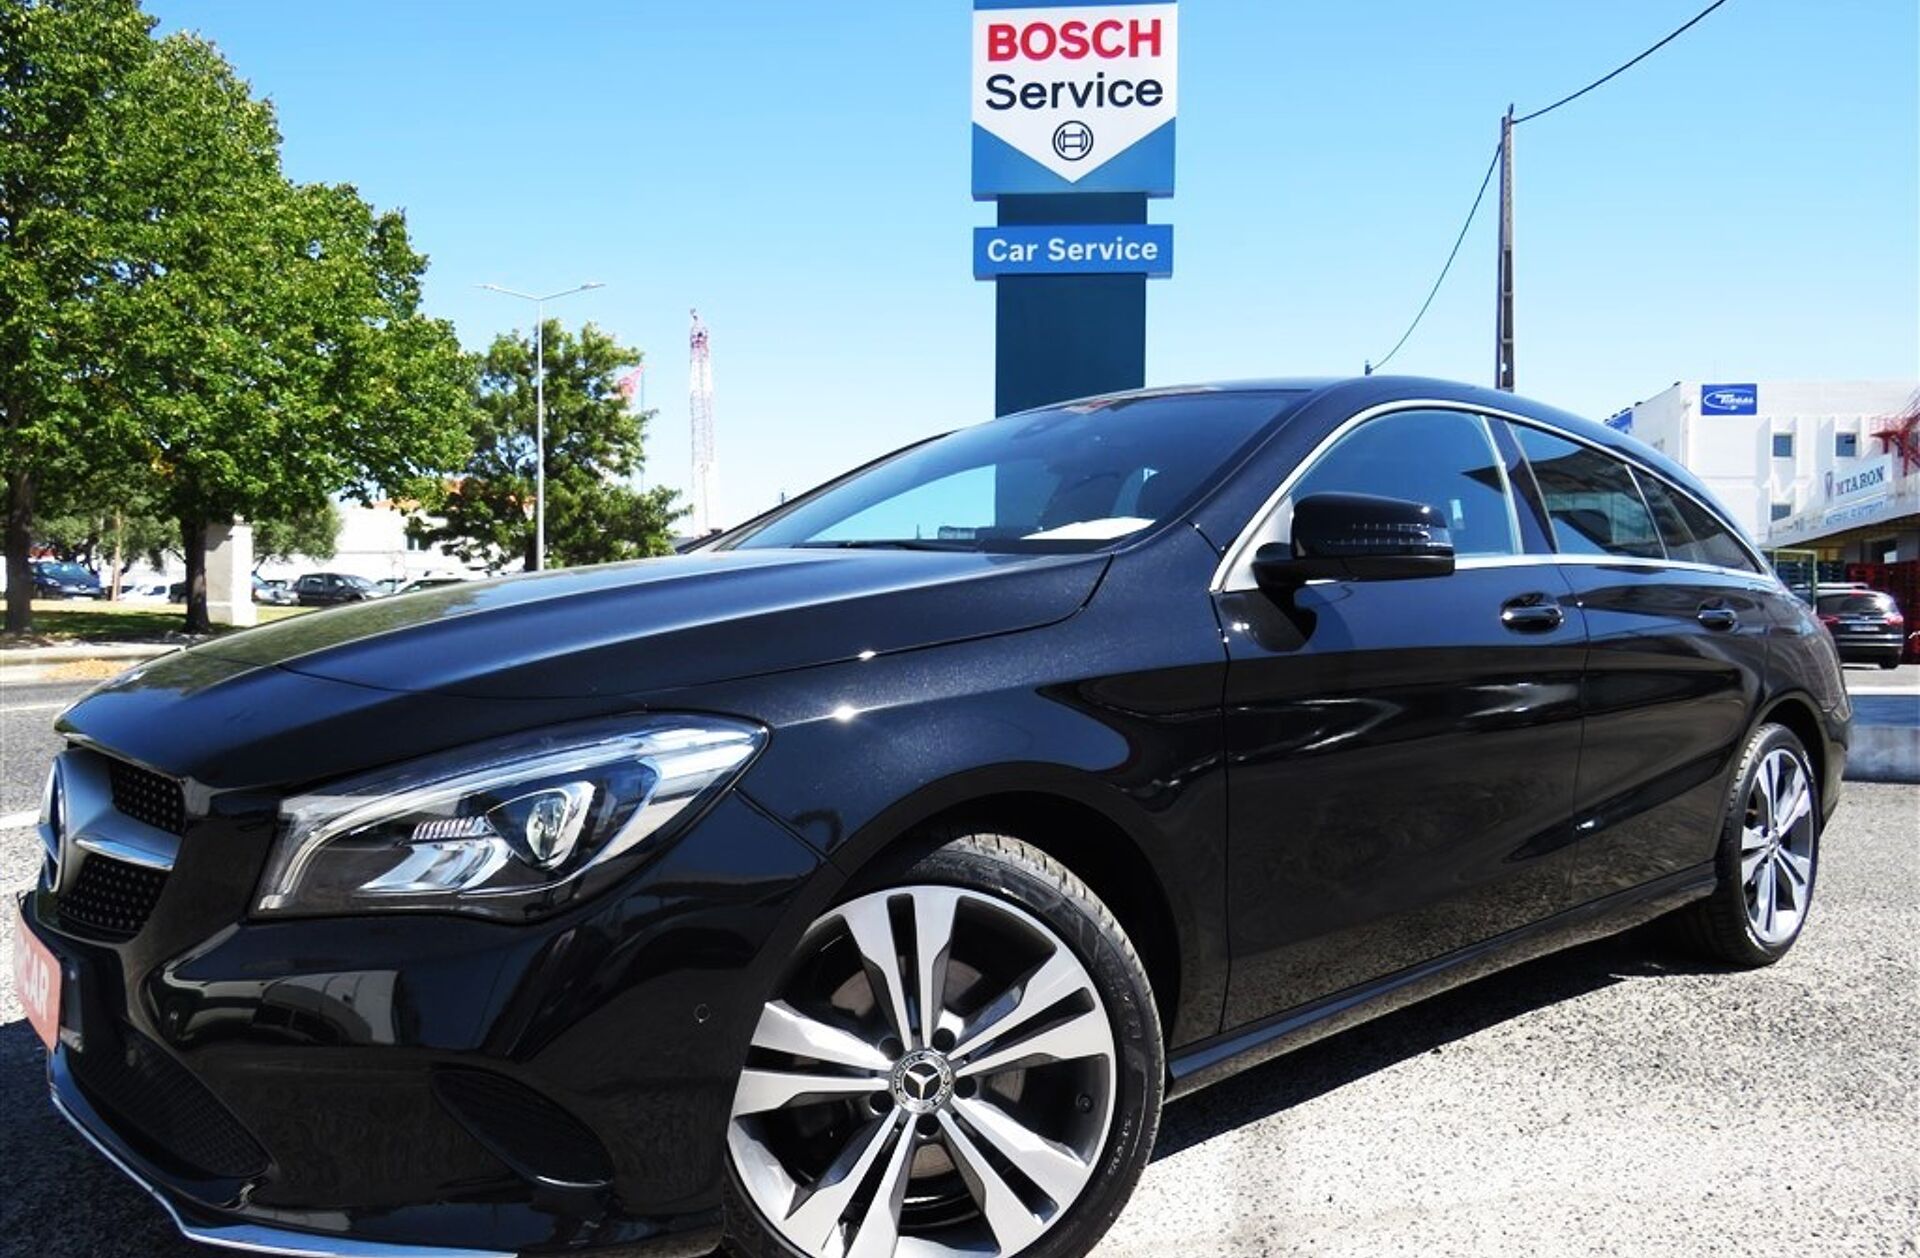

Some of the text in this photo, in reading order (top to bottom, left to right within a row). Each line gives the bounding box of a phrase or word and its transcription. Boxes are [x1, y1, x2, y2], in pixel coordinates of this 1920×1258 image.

[988, 19, 1162, 61] BOSCH
[986, 72, 1163, 110] Service
[987, 237, 1158, 262] Car Service
